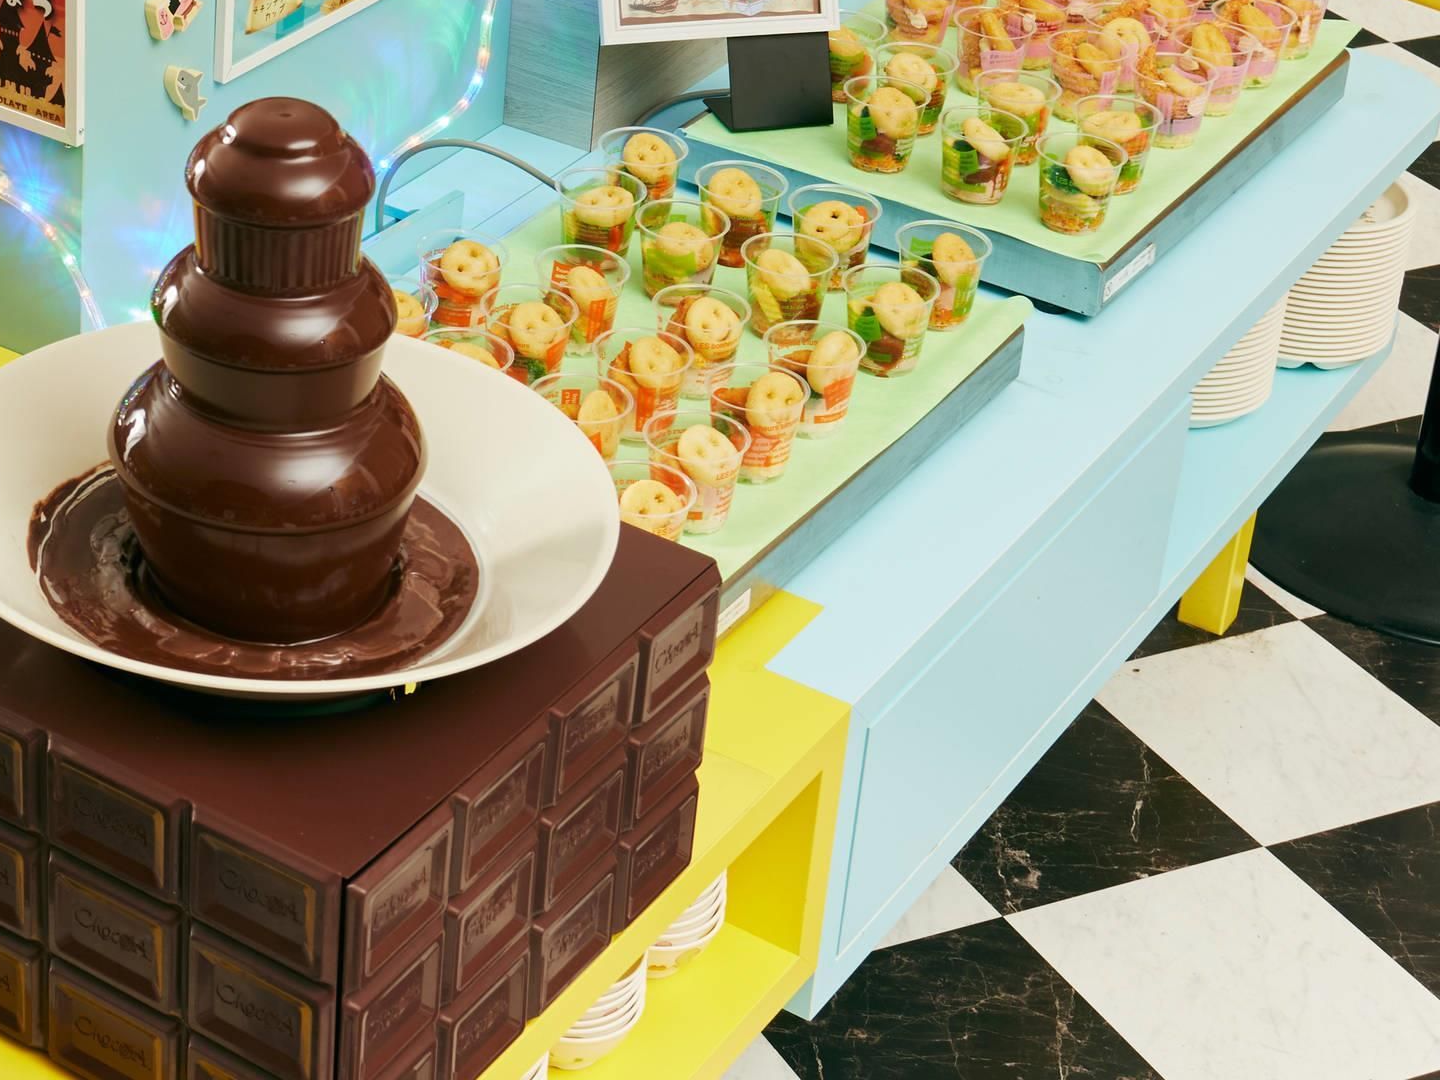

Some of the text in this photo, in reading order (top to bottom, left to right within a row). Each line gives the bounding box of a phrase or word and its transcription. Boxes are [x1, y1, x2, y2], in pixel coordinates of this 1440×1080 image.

[265, 3, 286, 22] カップ
[35, 108, 61, 122] AREA
